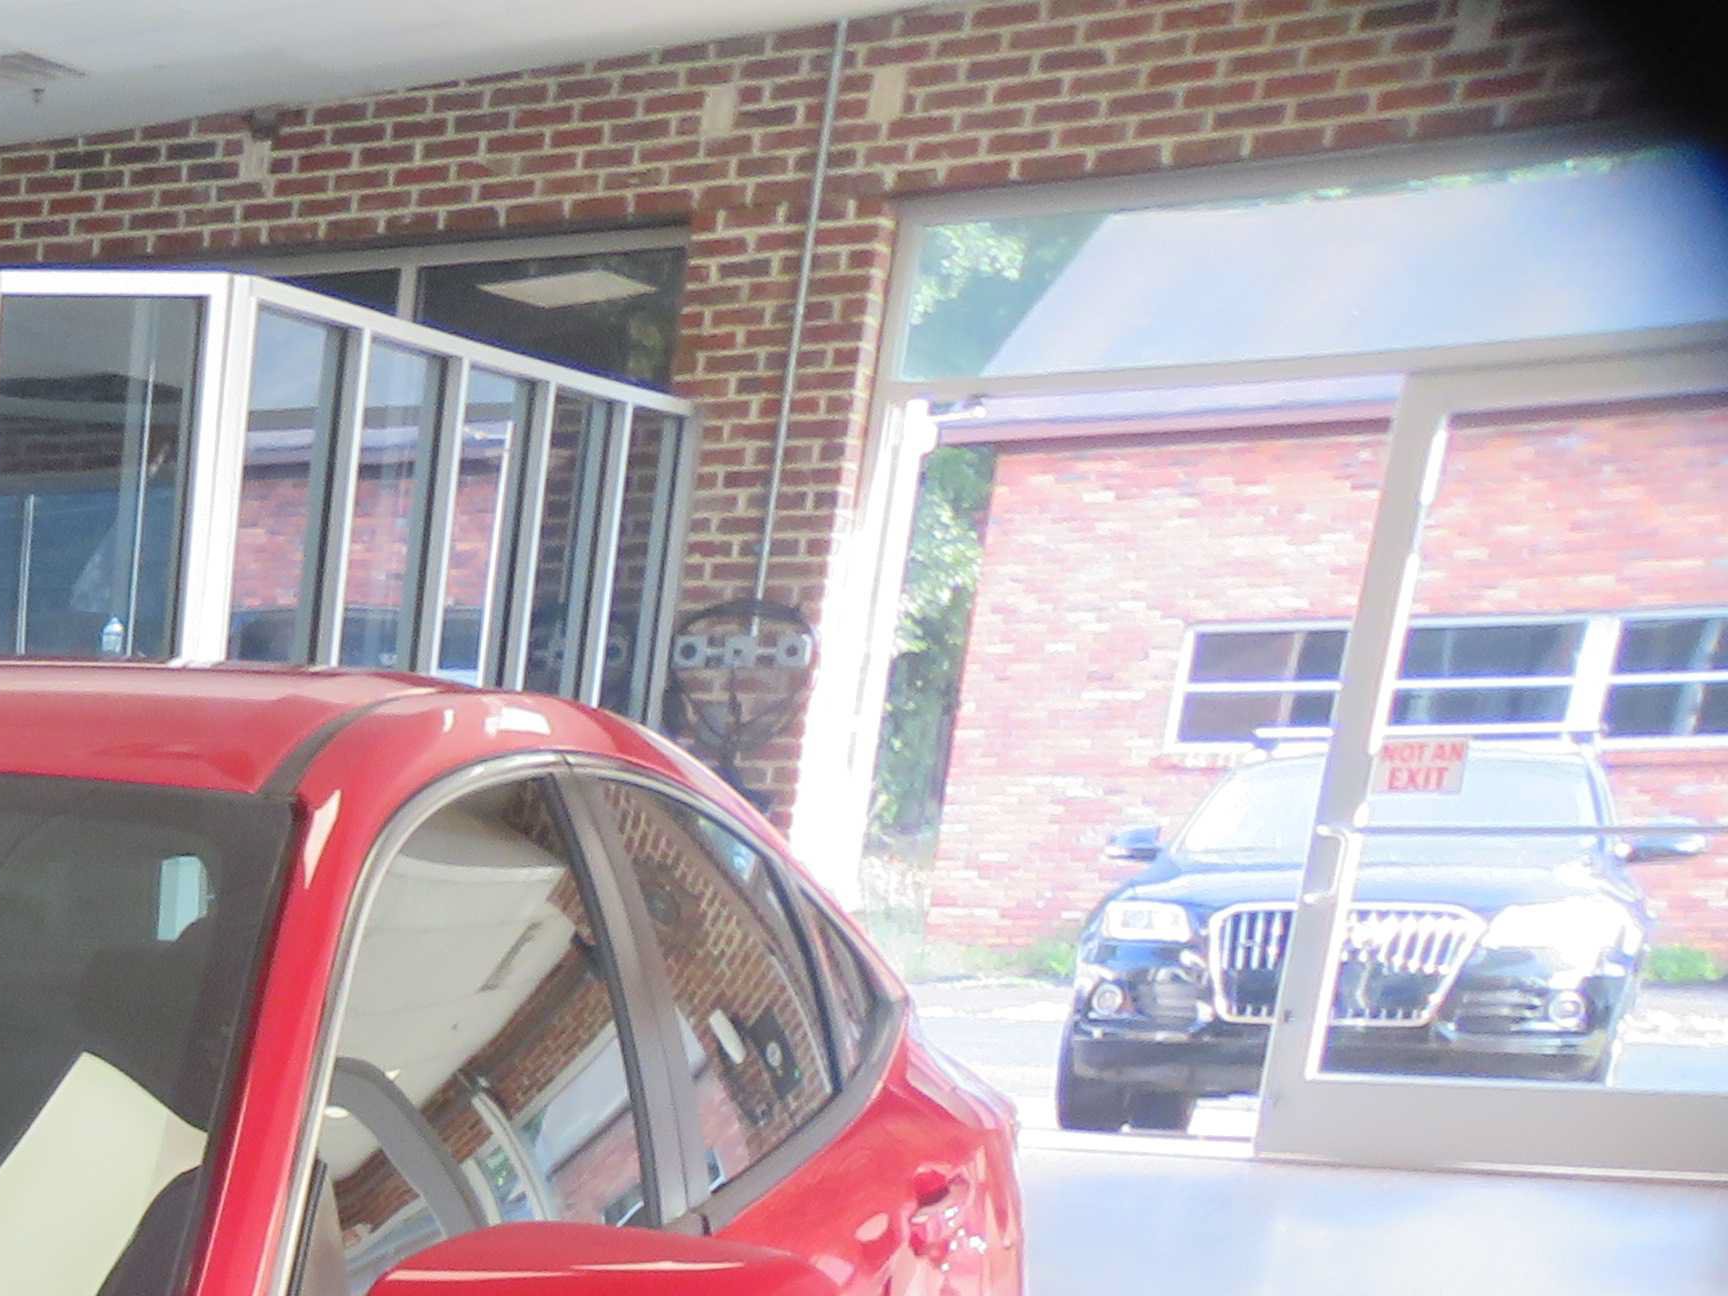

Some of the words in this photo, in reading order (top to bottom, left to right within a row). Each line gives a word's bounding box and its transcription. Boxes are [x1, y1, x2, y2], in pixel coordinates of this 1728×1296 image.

[1381, 742, 1426, 763] NOT
[1431, 742, 1465, 762] AN
[1388, 767, 1448, 791] EXIT
